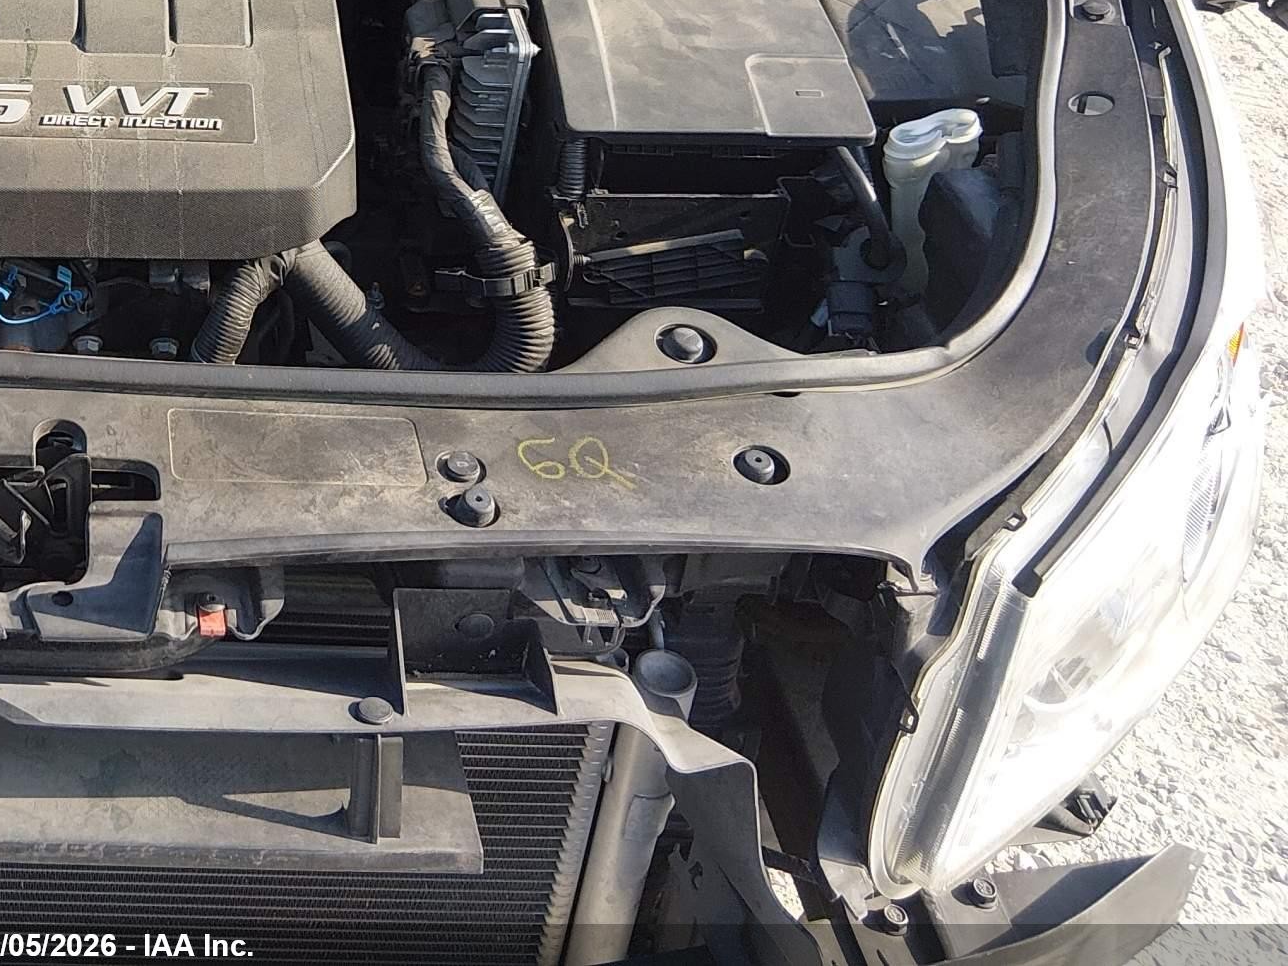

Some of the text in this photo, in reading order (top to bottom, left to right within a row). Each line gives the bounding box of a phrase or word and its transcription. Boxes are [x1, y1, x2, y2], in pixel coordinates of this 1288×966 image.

[62, 84, 209, 116] VVT
[39, 114, 224, 131] DIRECT INJECTION
